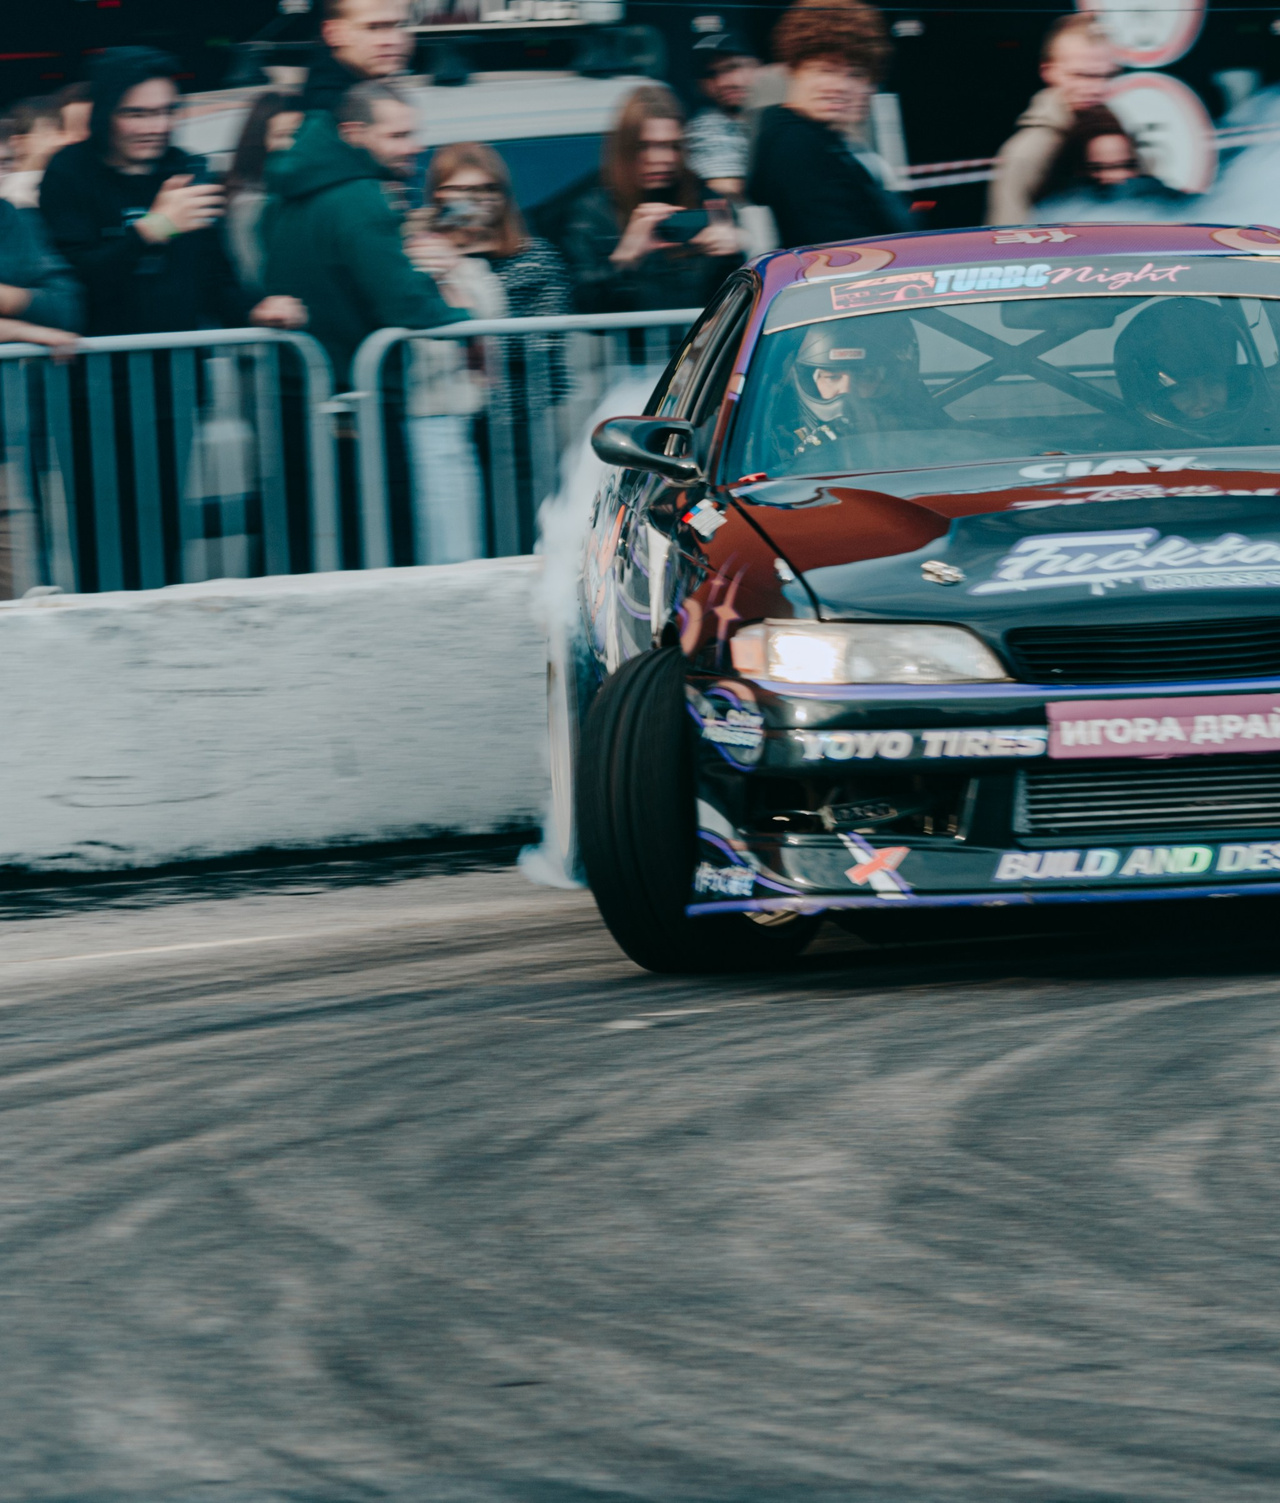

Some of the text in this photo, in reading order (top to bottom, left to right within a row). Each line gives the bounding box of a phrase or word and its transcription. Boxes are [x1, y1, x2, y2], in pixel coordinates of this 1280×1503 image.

[1045, 262, 1190, 290] Night
[802, 728, 1048, 761] YOYO TIRES
[1059, 715, 1188, 747] ИГОРА
[994, 848, 1120, 881] BUILD
[1119, 845, 1214, 878] AND
